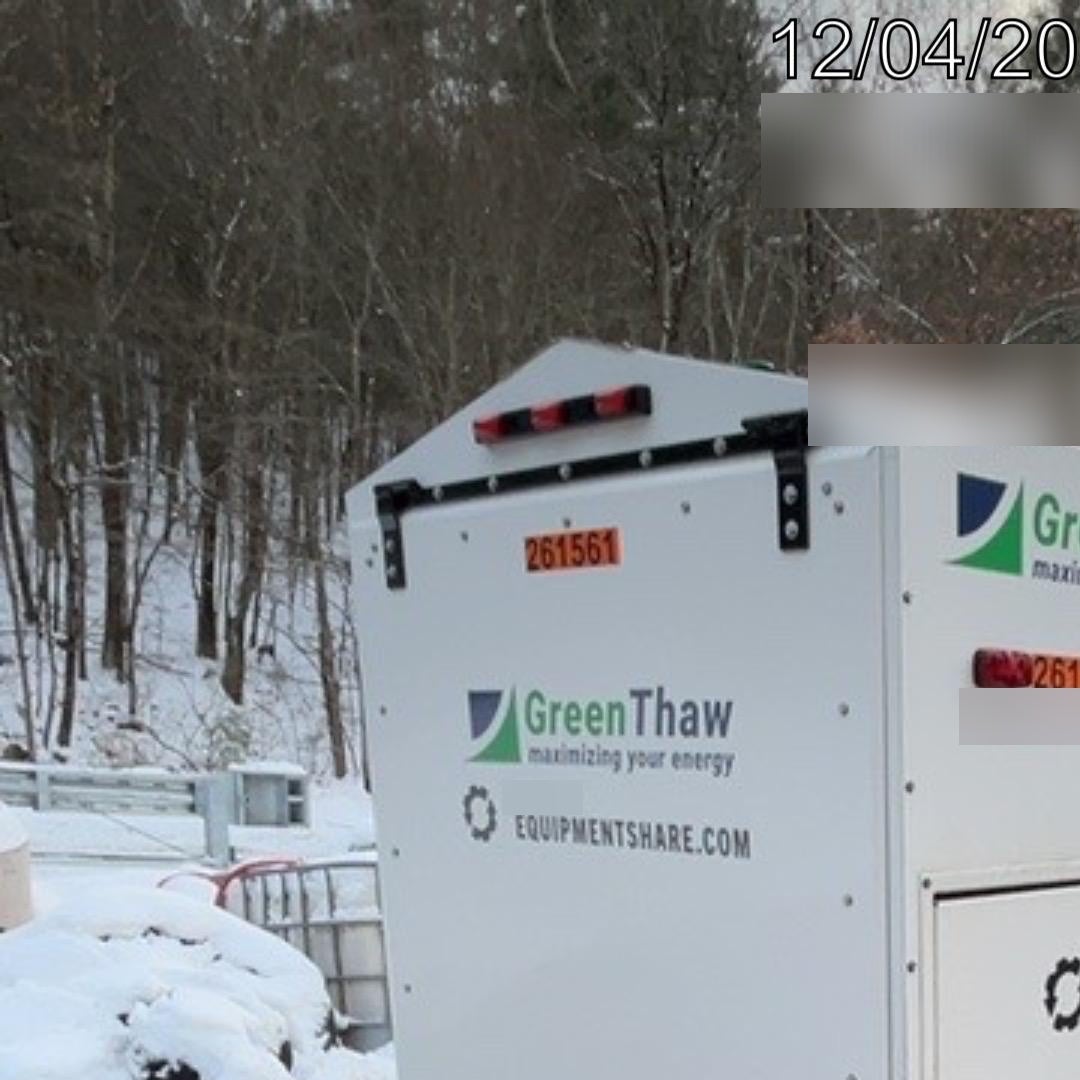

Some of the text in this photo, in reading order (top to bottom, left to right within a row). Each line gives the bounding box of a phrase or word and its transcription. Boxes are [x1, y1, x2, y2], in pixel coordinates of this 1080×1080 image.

[525, 529, 617, 571] 261561
[525, 686, 733, 738] GreenThaw
[528, 743, 735, 778] maximizing your energy
[515, 815, 751, 859] EQUIPMENTSHARE.COM
